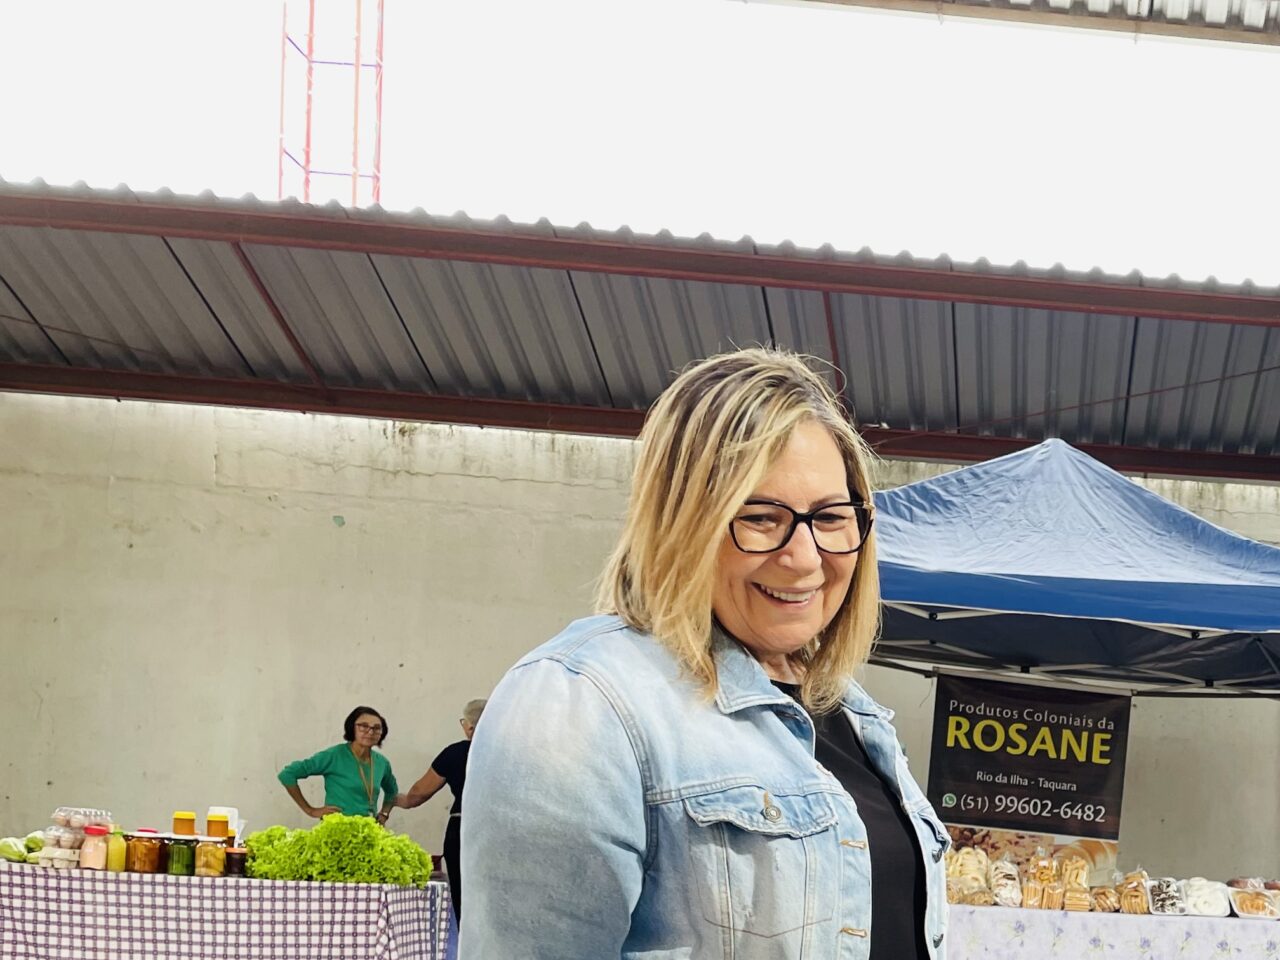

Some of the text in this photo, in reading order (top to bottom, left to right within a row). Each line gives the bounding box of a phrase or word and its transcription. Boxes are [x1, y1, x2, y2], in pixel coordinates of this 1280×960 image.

[950, 700, 1114, 730] Produtos Coloniais da
[947, 716, 1112, 764] ROSANE
[976, 771, 993, 782] Rio
[995, 773, 1008, 784] da
[1010, 775, 1029, 786] Ilha
[1038, 778, 1077, 791] Taquara
[960, 794, 1106, 822] (51) 99602-6482
